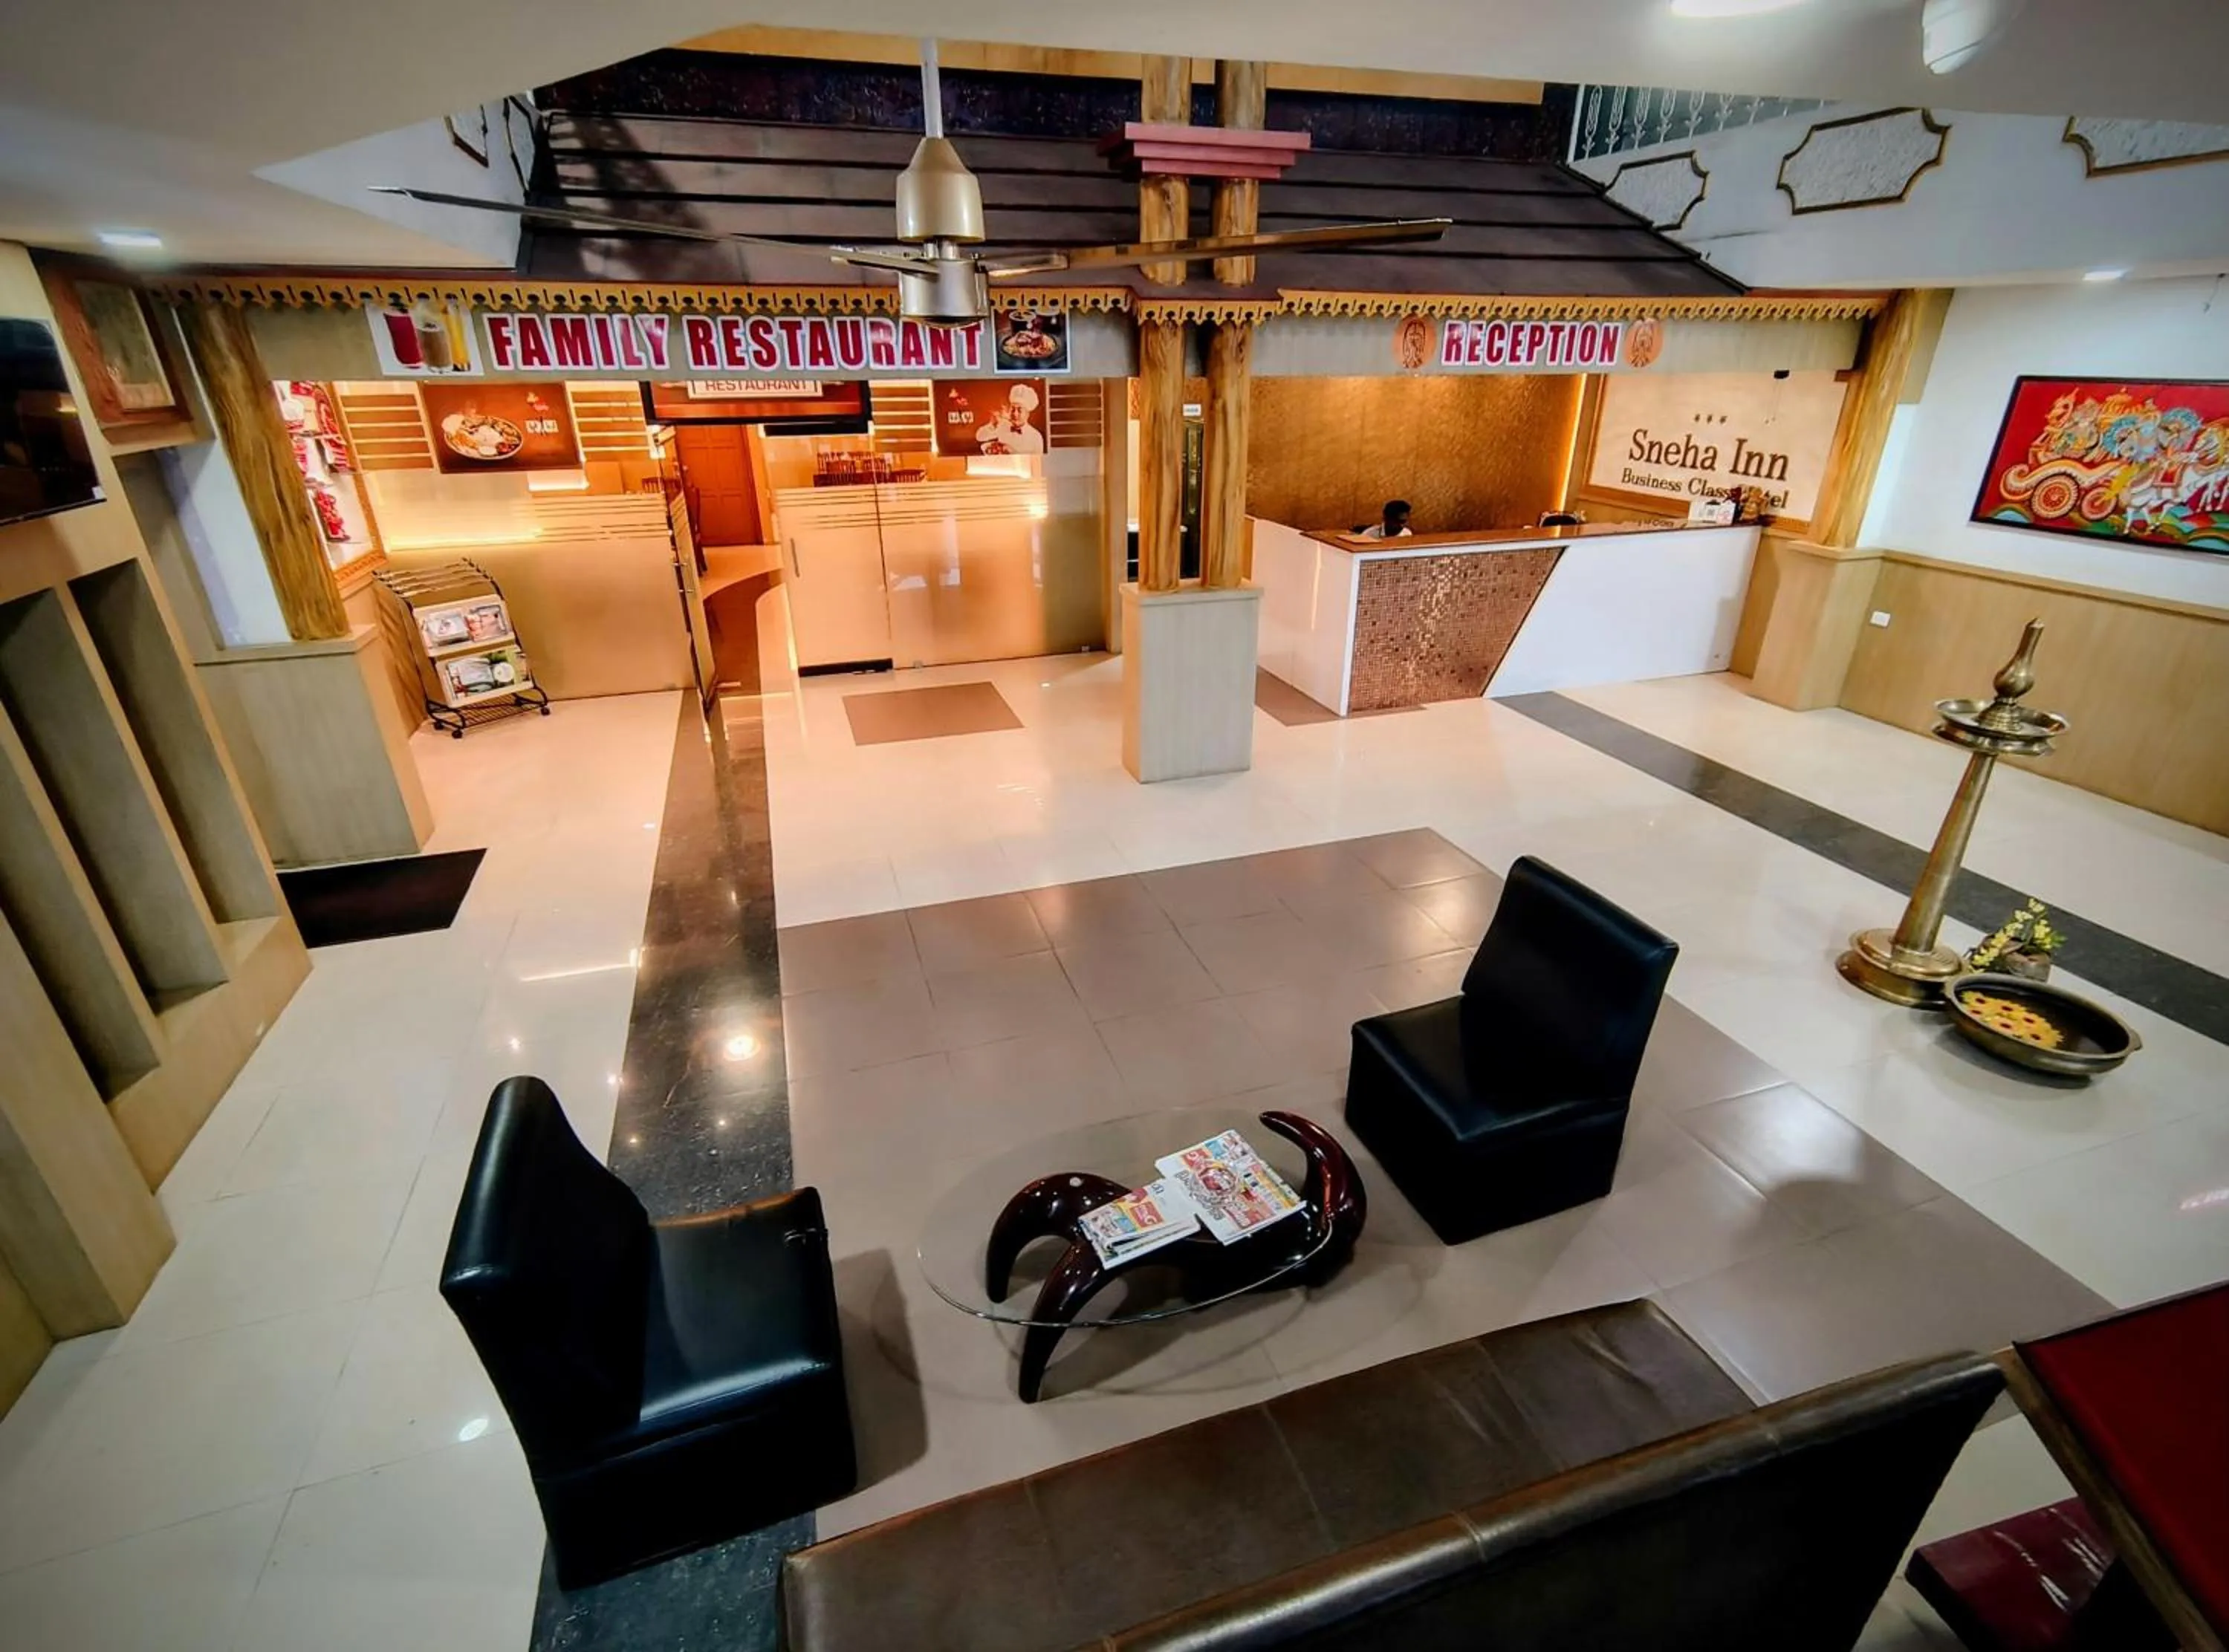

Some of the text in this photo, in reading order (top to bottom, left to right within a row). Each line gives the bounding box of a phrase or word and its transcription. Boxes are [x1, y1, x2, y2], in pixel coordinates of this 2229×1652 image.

[483, 314, 984, 369] FAMILY RESTAURANT
[1441, 320, 1621, 365] RECEPTION
[706, 380, 807, 391] RESTAURANT
[1629, 429, 1789, 481] Sneha Inn
[1621, 468, 1683, 492] Business
[1688, 477, 1731, 498] Class
